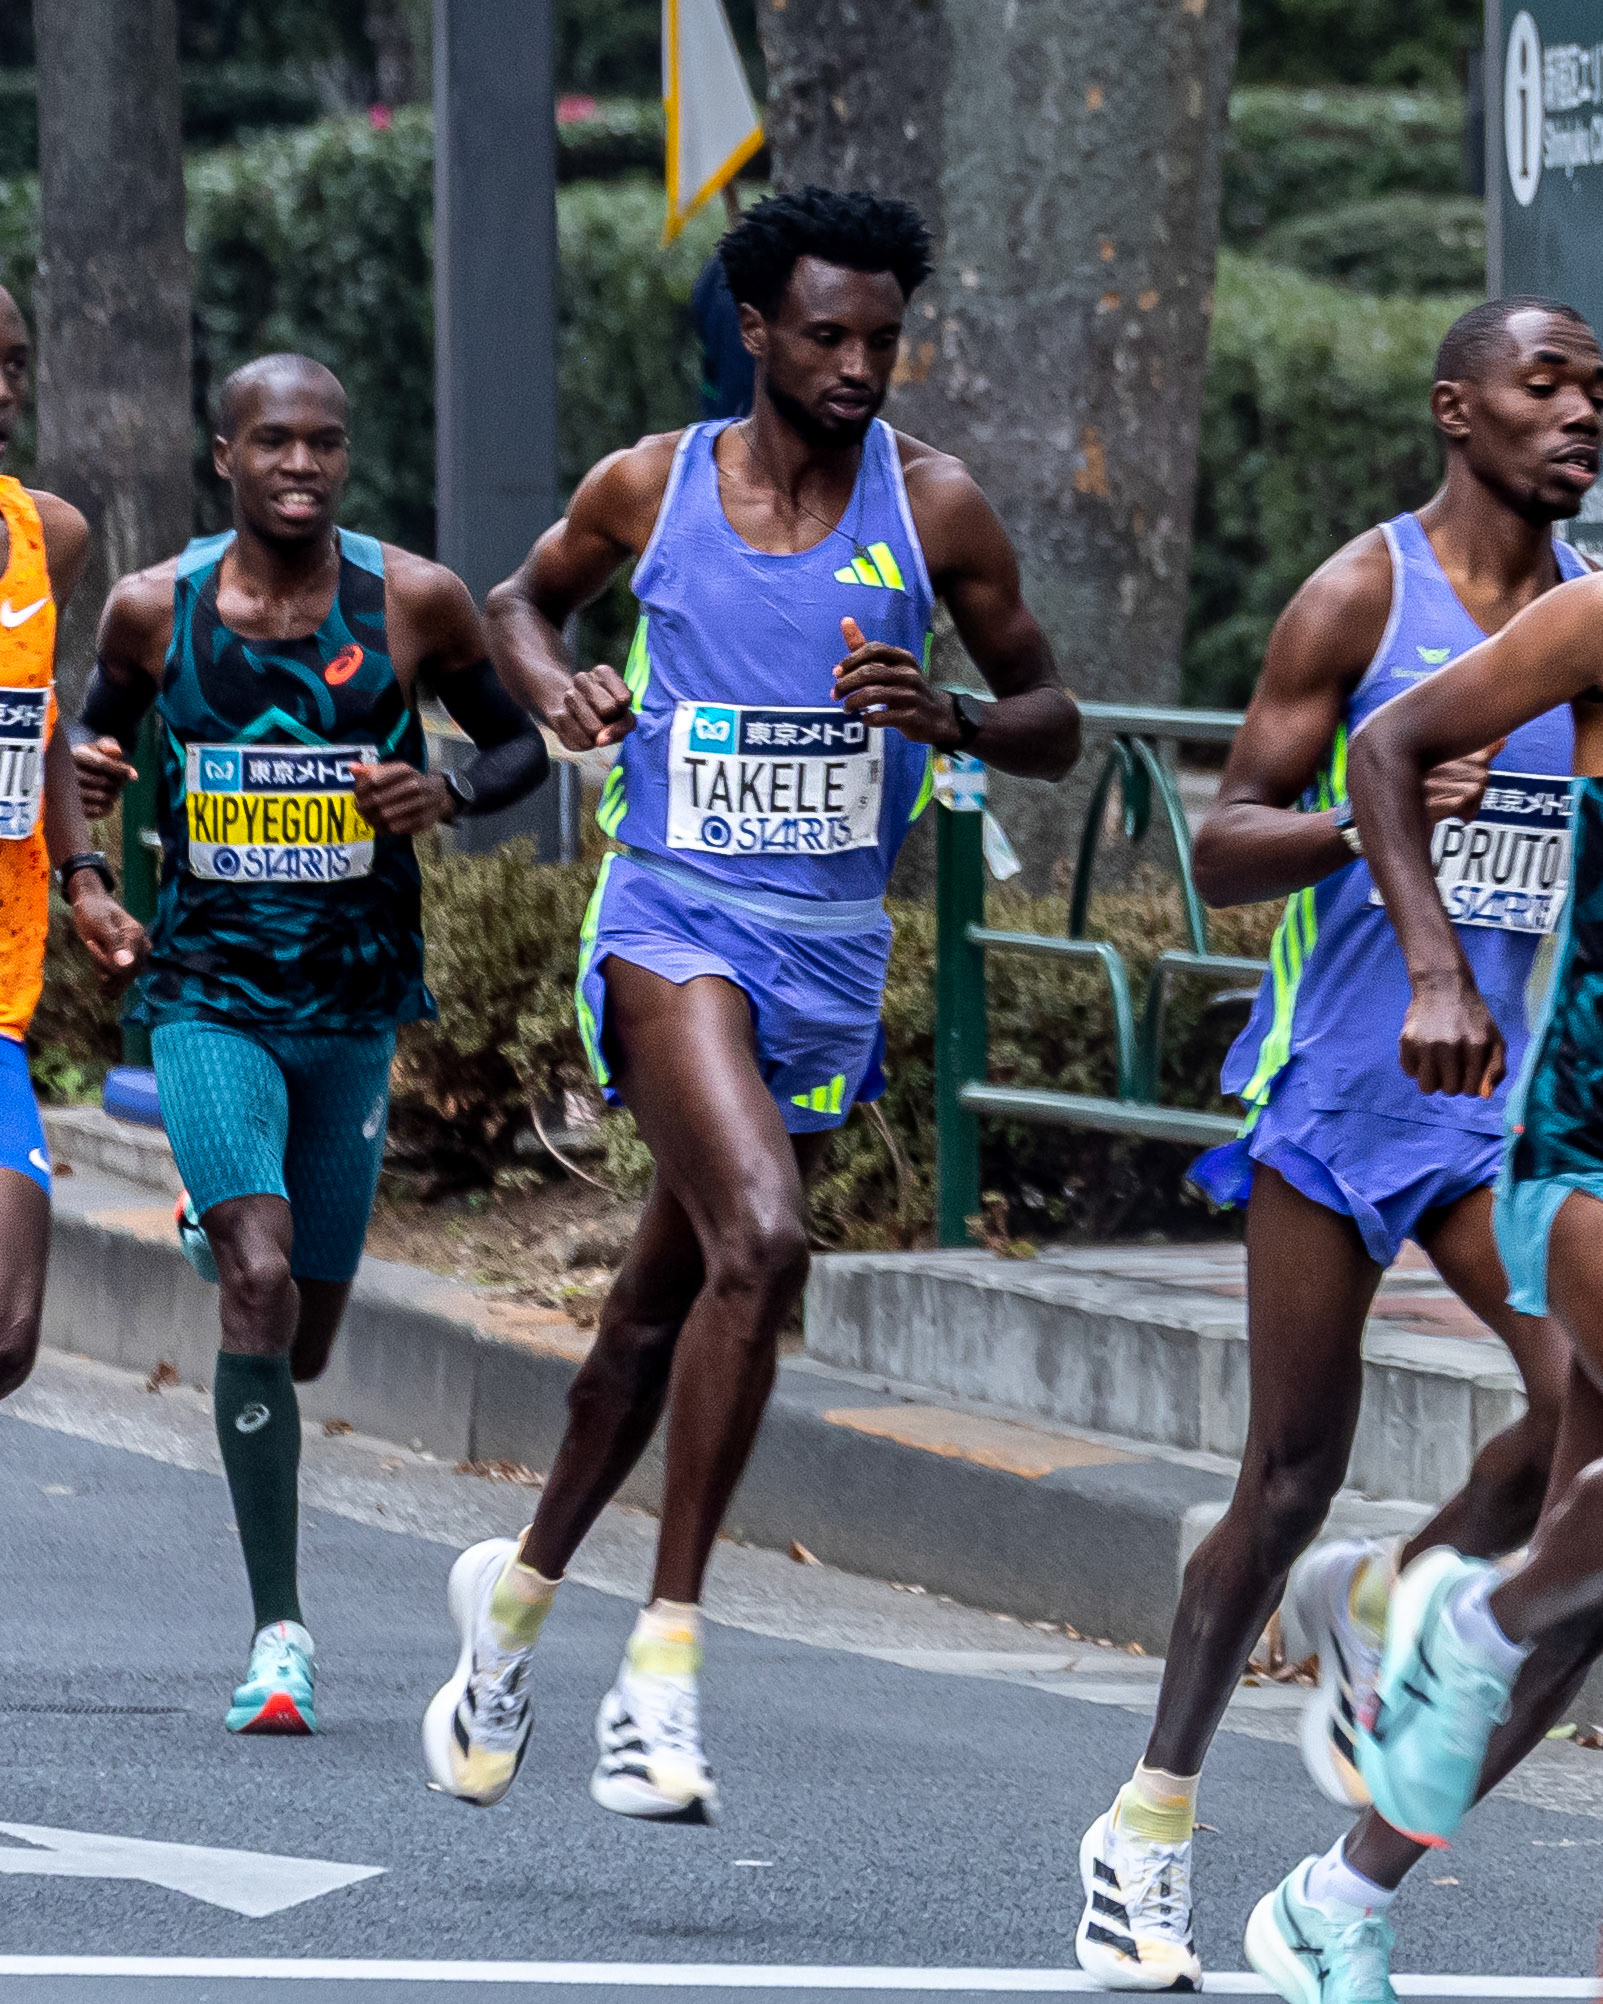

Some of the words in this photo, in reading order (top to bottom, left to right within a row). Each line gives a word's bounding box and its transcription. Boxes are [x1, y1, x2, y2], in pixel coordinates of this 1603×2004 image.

[745, 721, 864, 746] 東京メトロ
[682, 757, 847, 813] TAKELE
[193, 793, 346, 843] KIPYEGON
